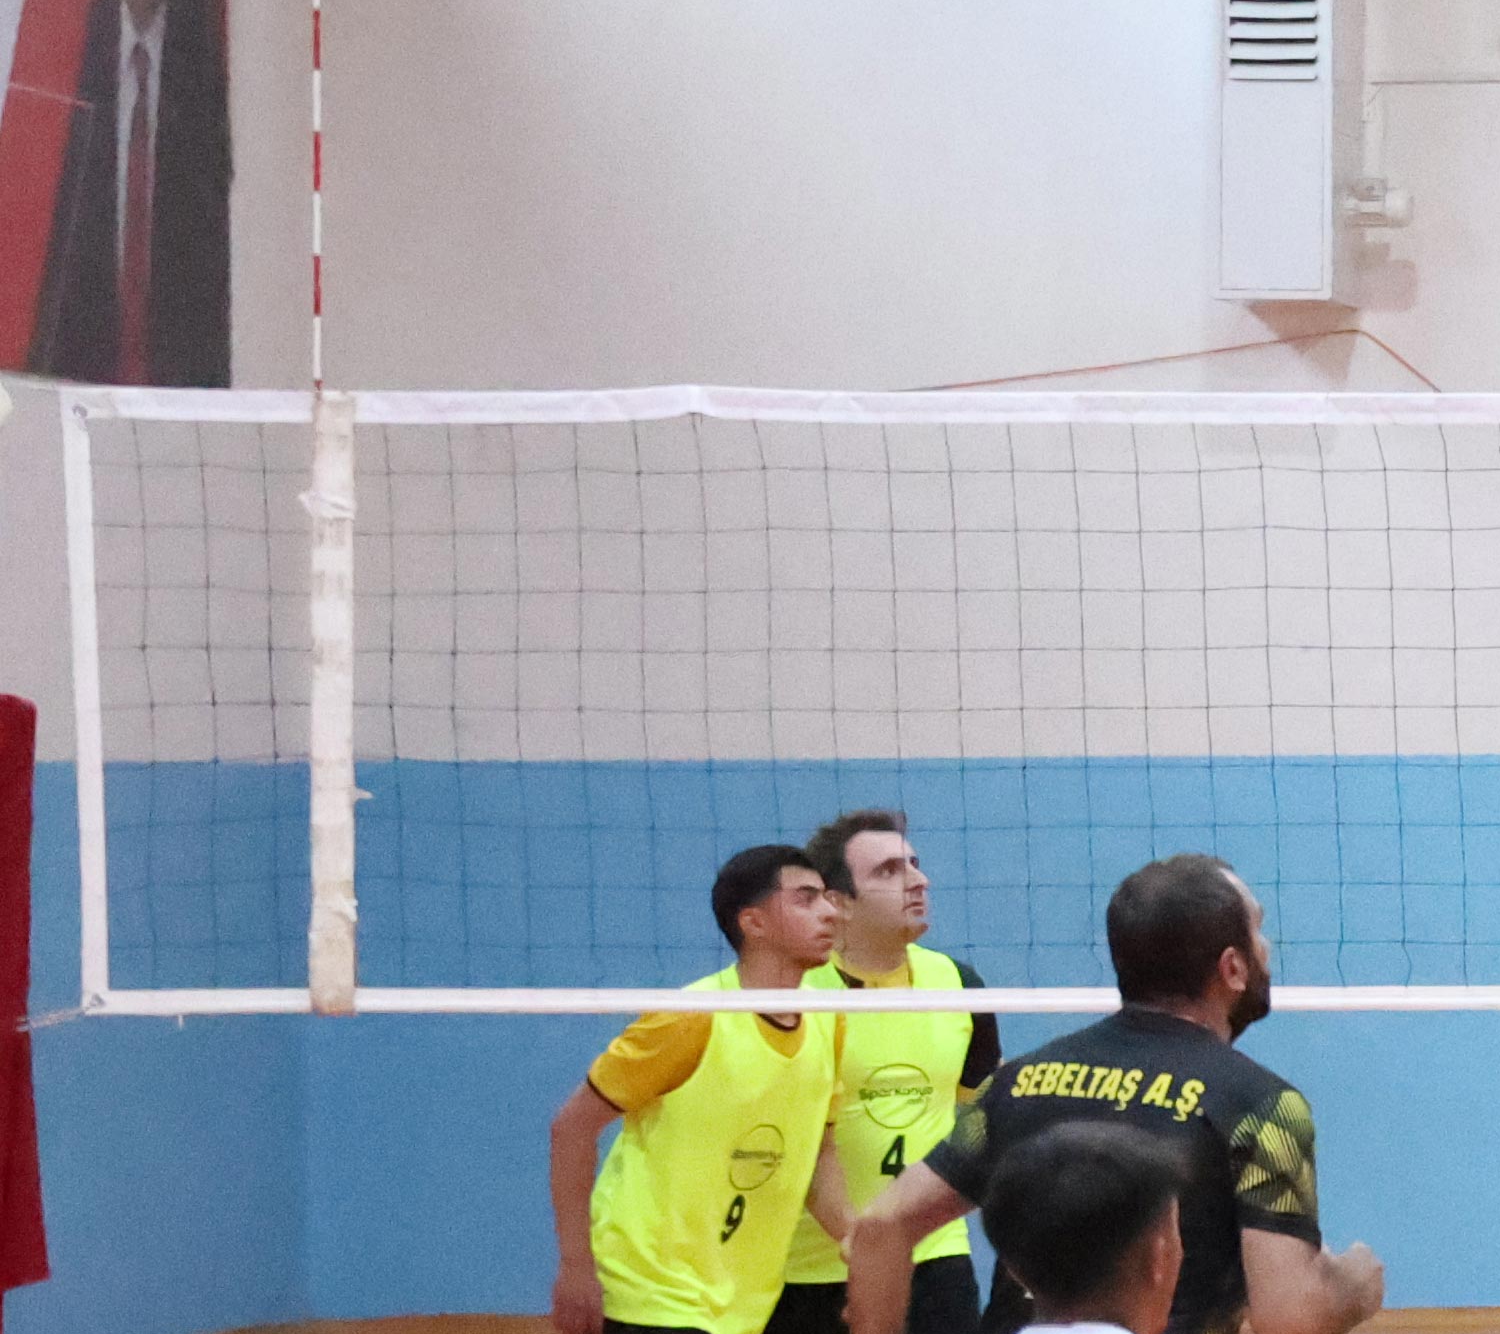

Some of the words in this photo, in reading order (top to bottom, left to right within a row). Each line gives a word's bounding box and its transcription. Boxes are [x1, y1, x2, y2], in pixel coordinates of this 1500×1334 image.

[1010, 1061, 1144, 1112] SEBELTAŞ
[880, 1134, 906, 1179] 4
[721, 1194, 746, 1243] 9
